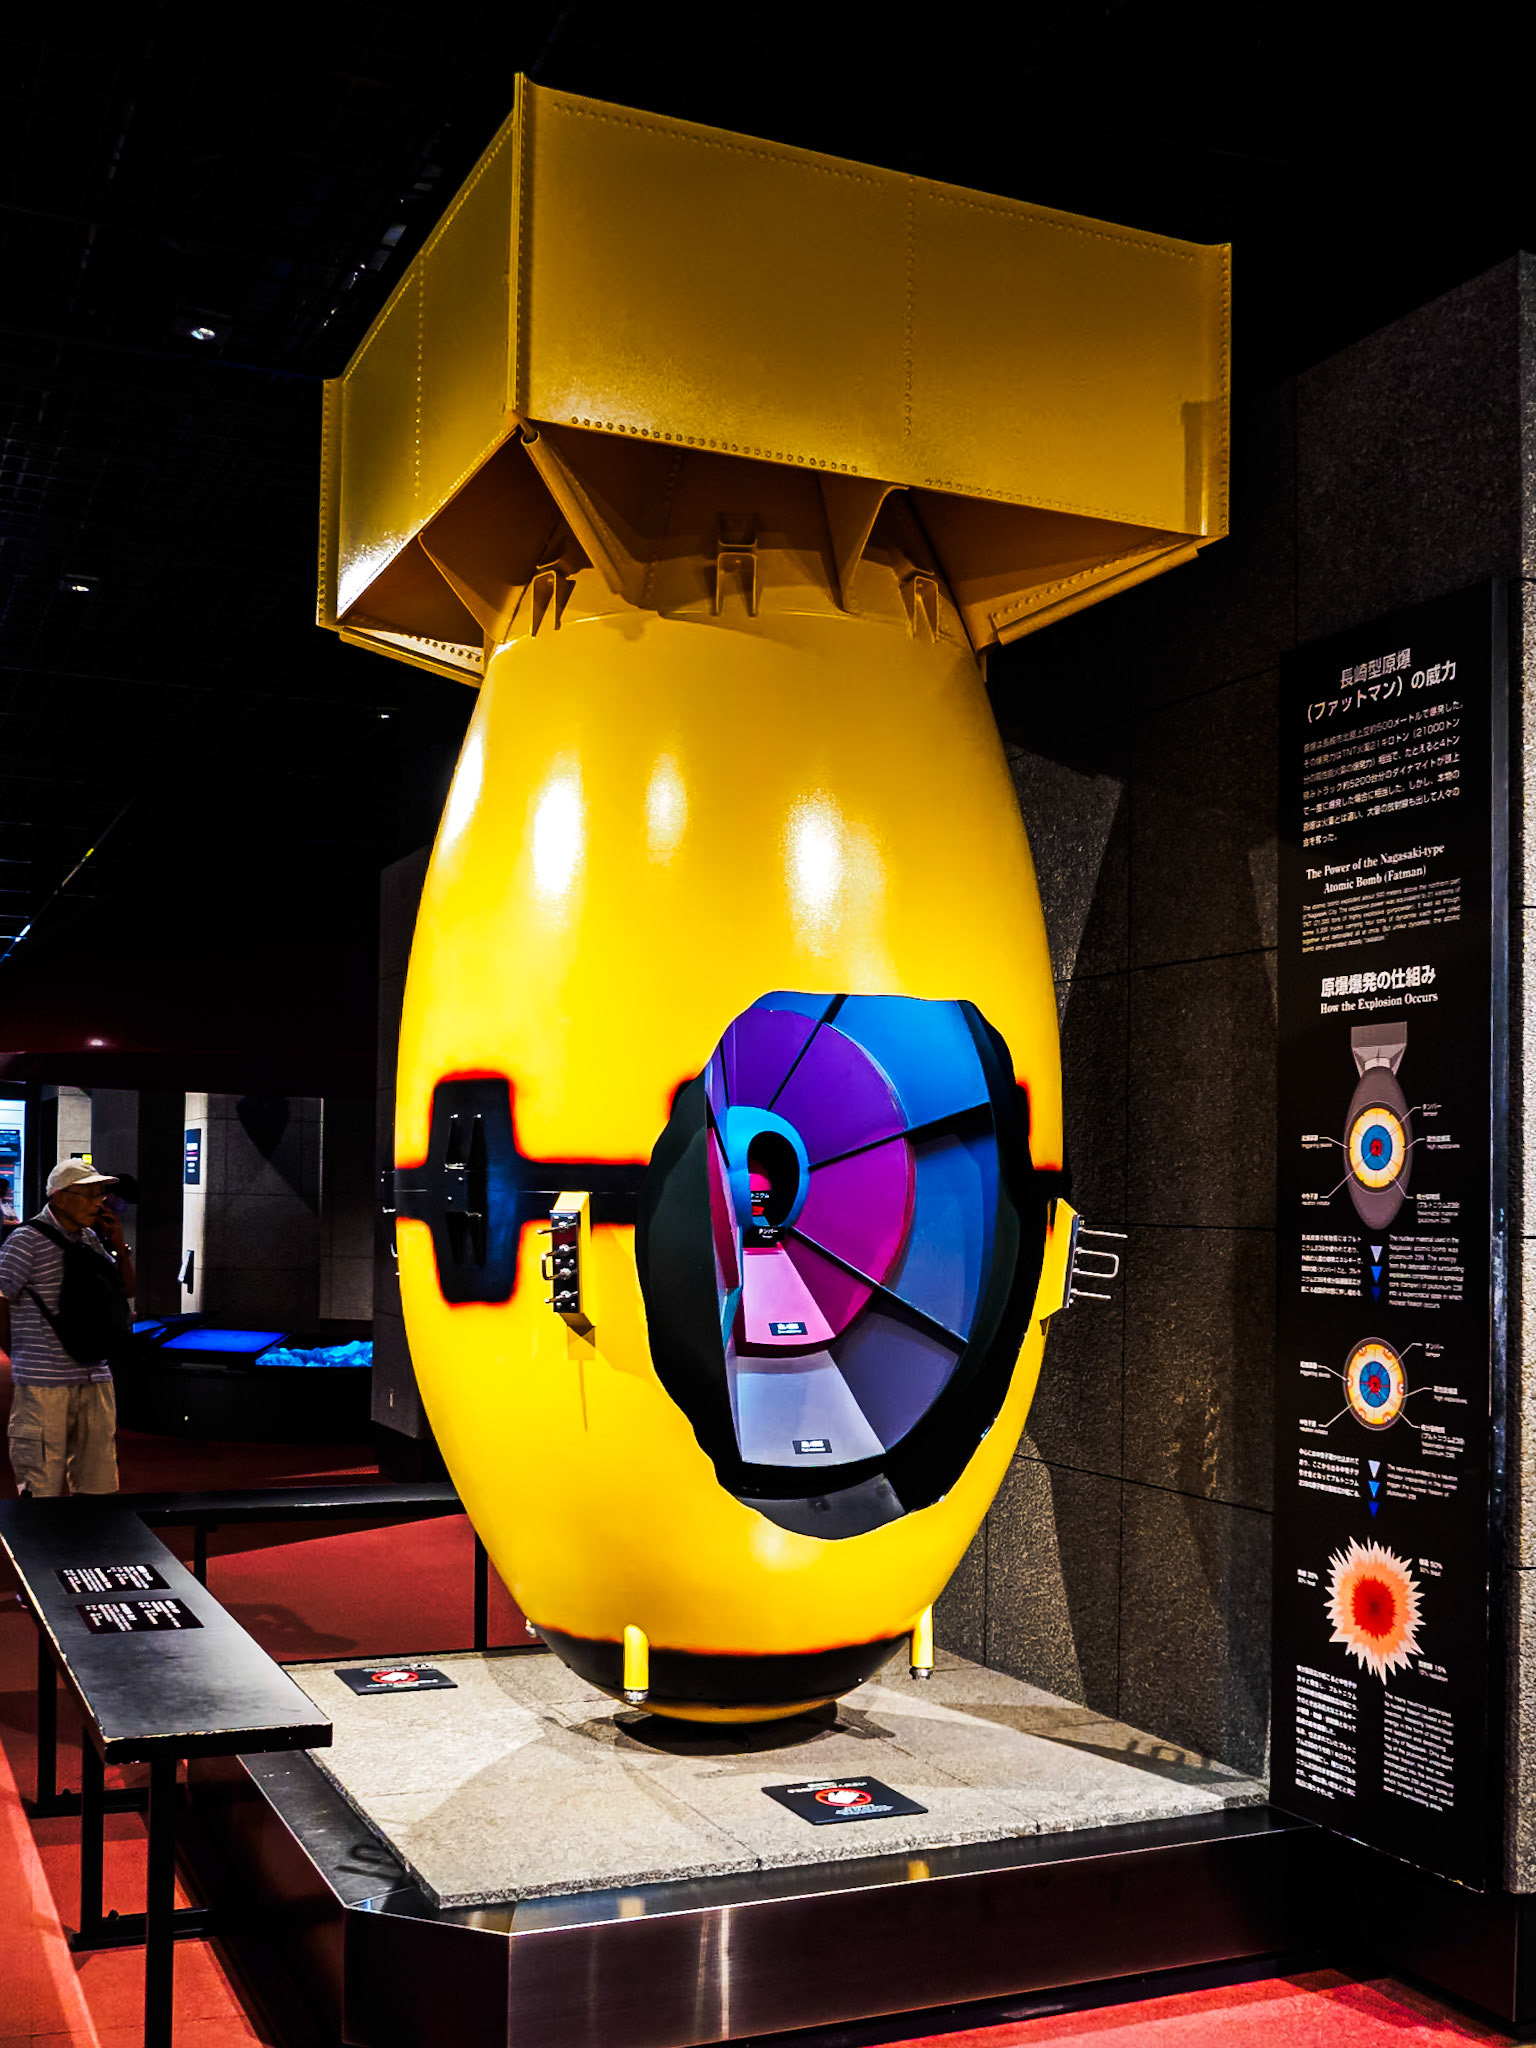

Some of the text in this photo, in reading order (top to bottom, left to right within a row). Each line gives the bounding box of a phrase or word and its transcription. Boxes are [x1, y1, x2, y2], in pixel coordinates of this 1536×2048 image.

[1340, 647, 1411, 690] 長崎型原爆
[1306, 843, 1446, 881] The Power of the Nagasaki-type
[1323, 865, 1426, 894] Atomic Bomb (Fatman)
[1320, 964, 1436, 998] 原爆爆発の仕組み
[1320, 992, 1438, 1014] How the Explosion Occurs
